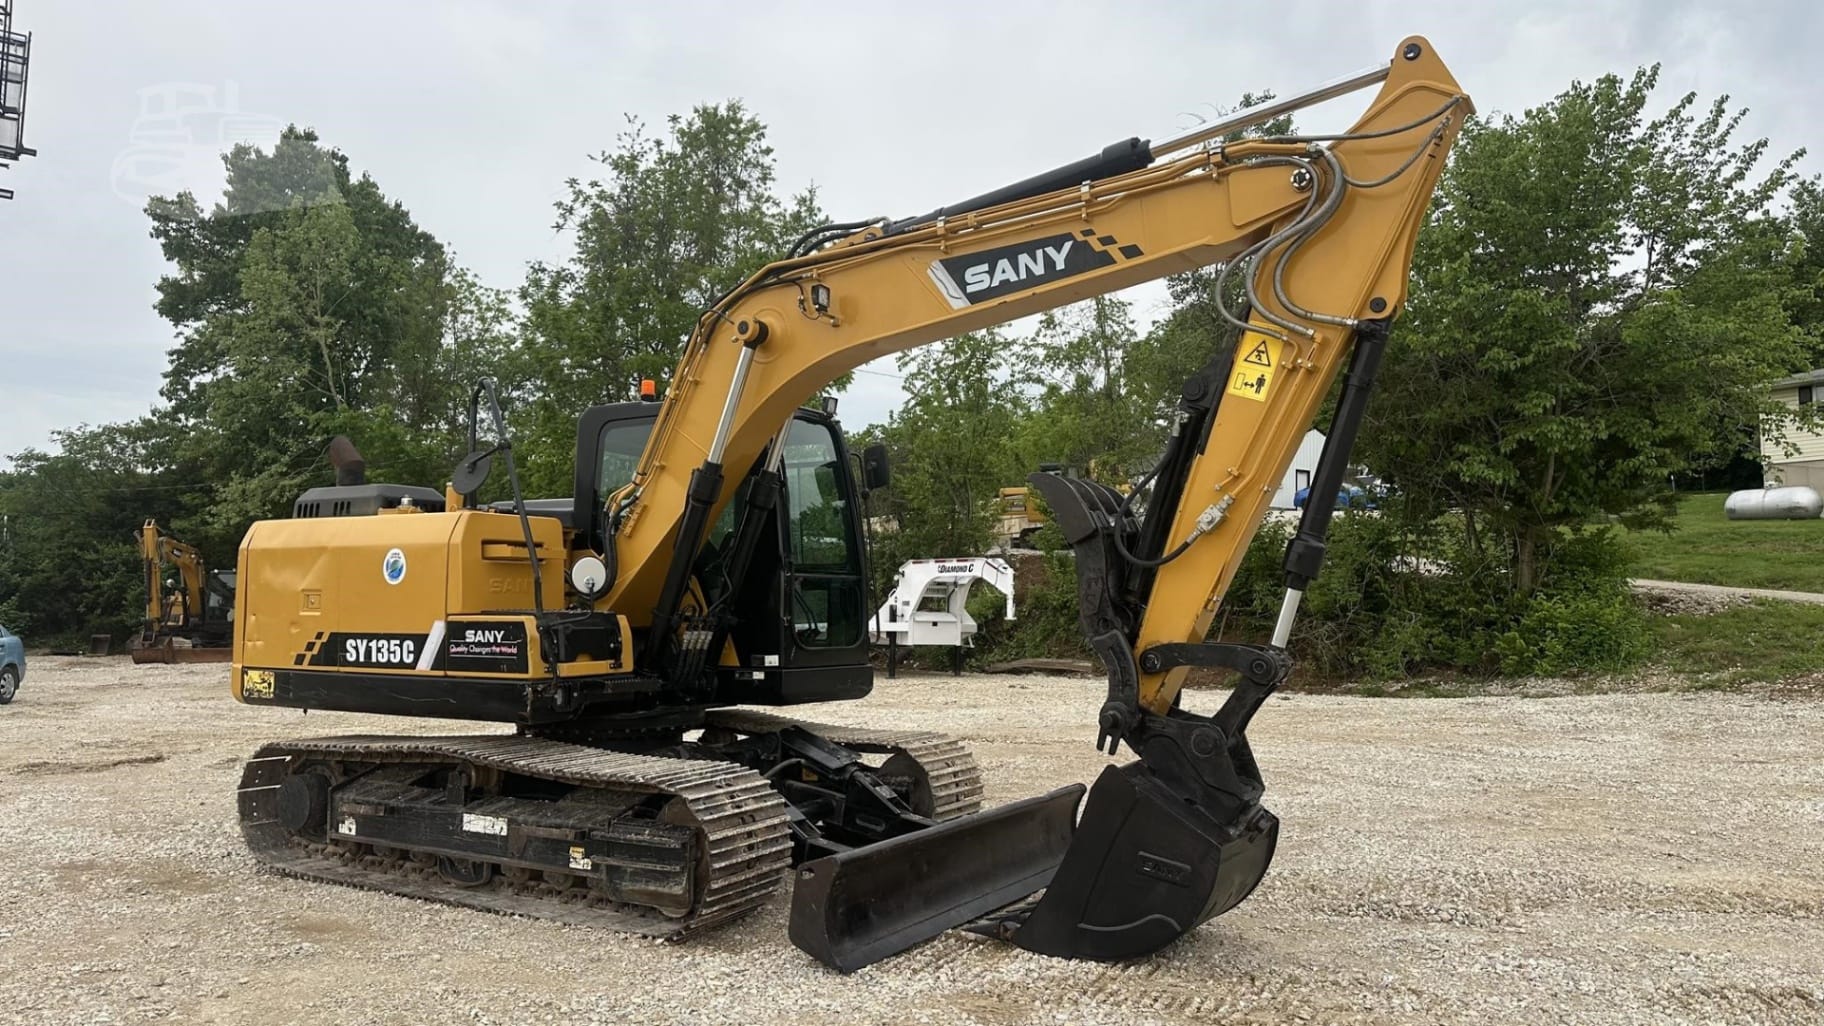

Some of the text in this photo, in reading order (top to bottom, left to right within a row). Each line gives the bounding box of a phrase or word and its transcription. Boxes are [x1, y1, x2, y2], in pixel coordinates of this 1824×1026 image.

[964, 240, 1074, 294] SANY
[968, 563, 974, 573] C
[465, 629, 505, 643] SANY
[345, 638, 415, 663] SY135C
[449, 644, 468, 654] Quality
[500, 645, 517, 654] World
